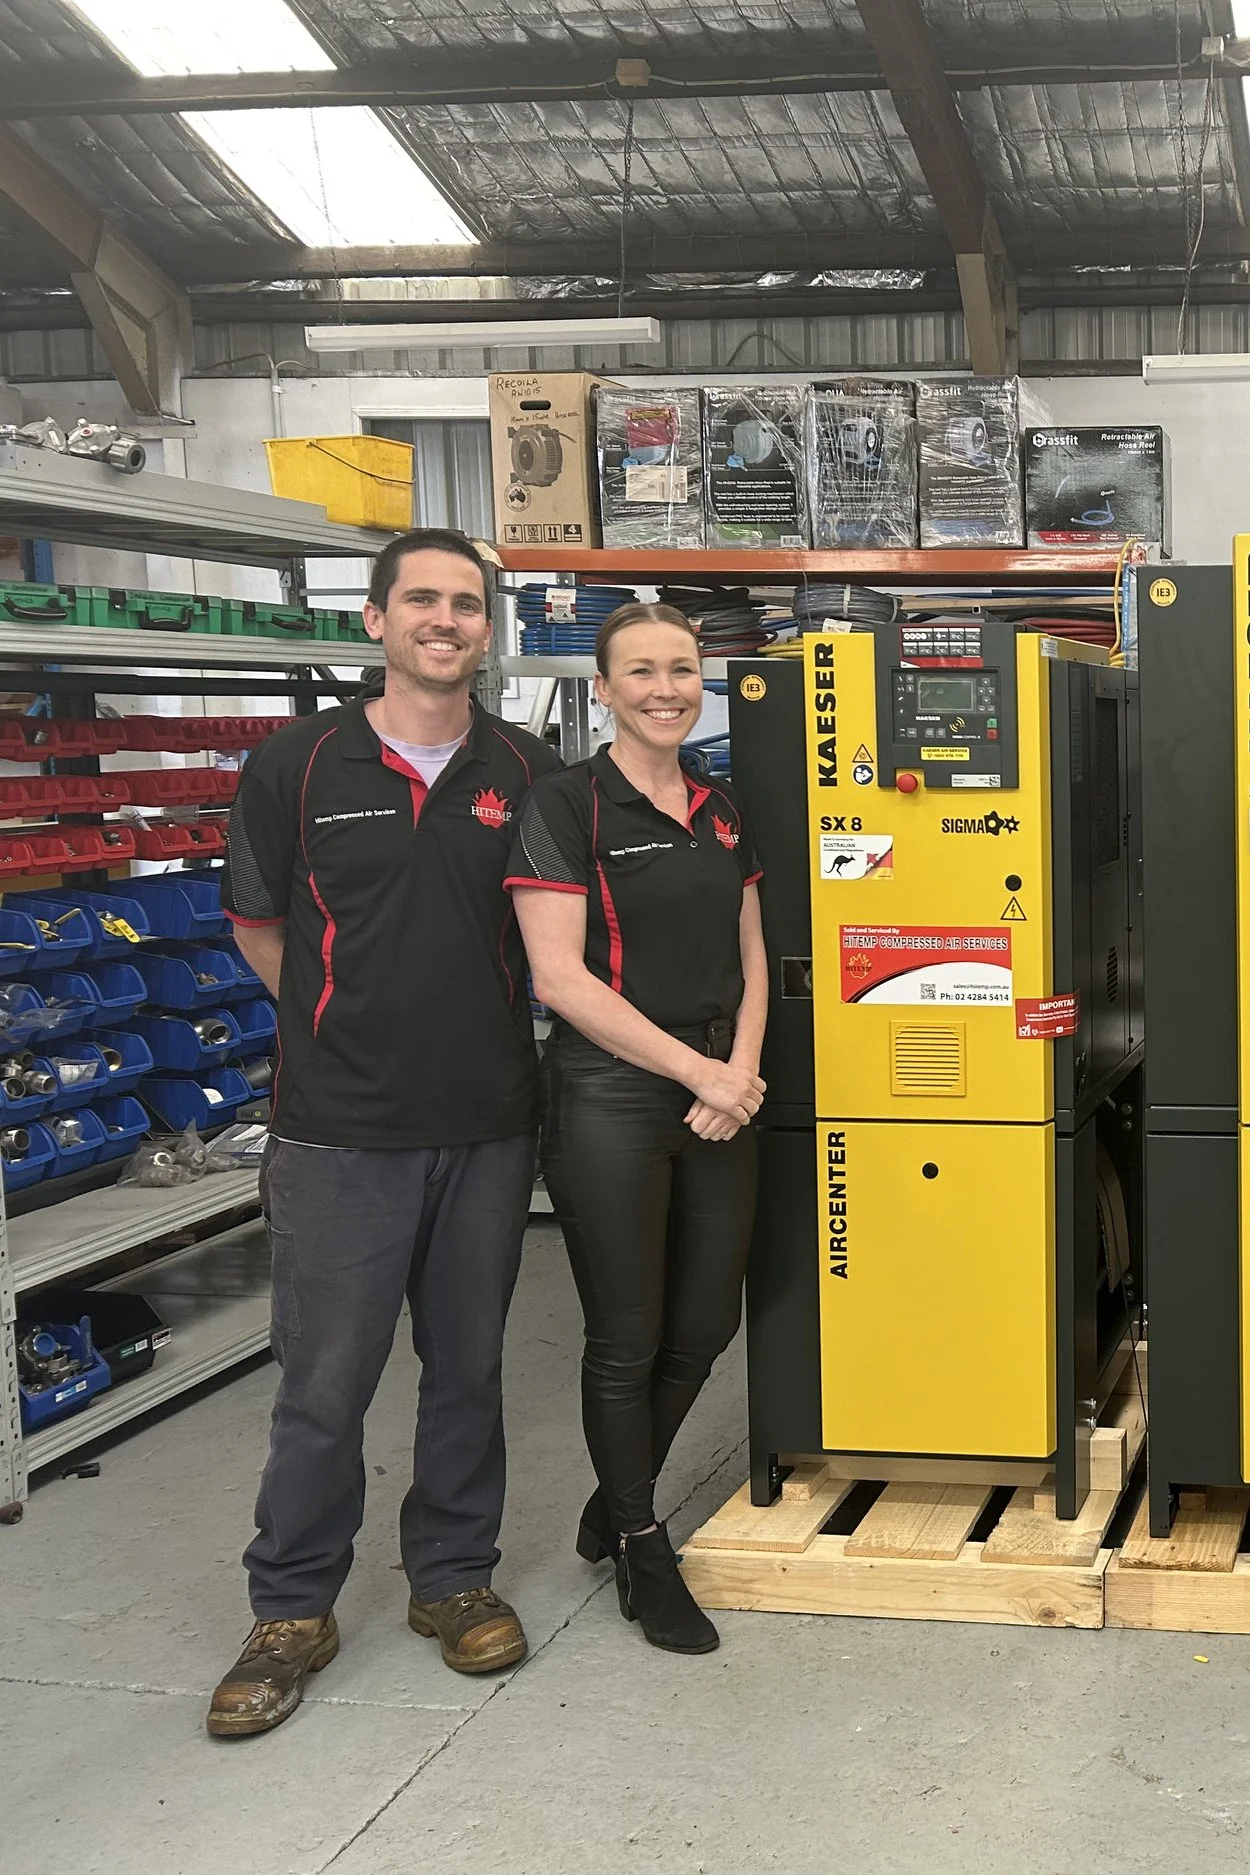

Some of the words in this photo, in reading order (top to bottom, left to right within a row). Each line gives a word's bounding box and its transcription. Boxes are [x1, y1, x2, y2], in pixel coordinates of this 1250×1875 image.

[1101, 433, 1142, 441] Retractable
[1143, 432, 1156, 440] Air
[1118, 441, 1137, 449] Hose
[1156, 588, 1171, 597] IE3
[746, 684, 760, 692] IE3
[814, 643, 838, 787] KAESER
[470, 805, 513, 823] HITEMP
[820, 816, 847, 832] SX
[851, 816, 863, 832] 8
[942, 818, 985, 834] SIGMA
[843, 935, 878, 949] HITEMP
[879, 936, 944, 950] COMPRESSED
[944, 937, 962, 950] AIR
[962, 937, 1009, 950] SERVICES
[940, 993, 954, 1001] Ph:
[955, 993, 967, 1001] 02
[966, 993, 987, 1001] 4284
[989, 993, 1009, 1002] 5414
[827, 1132, 848, 1280] AIRCENTER
